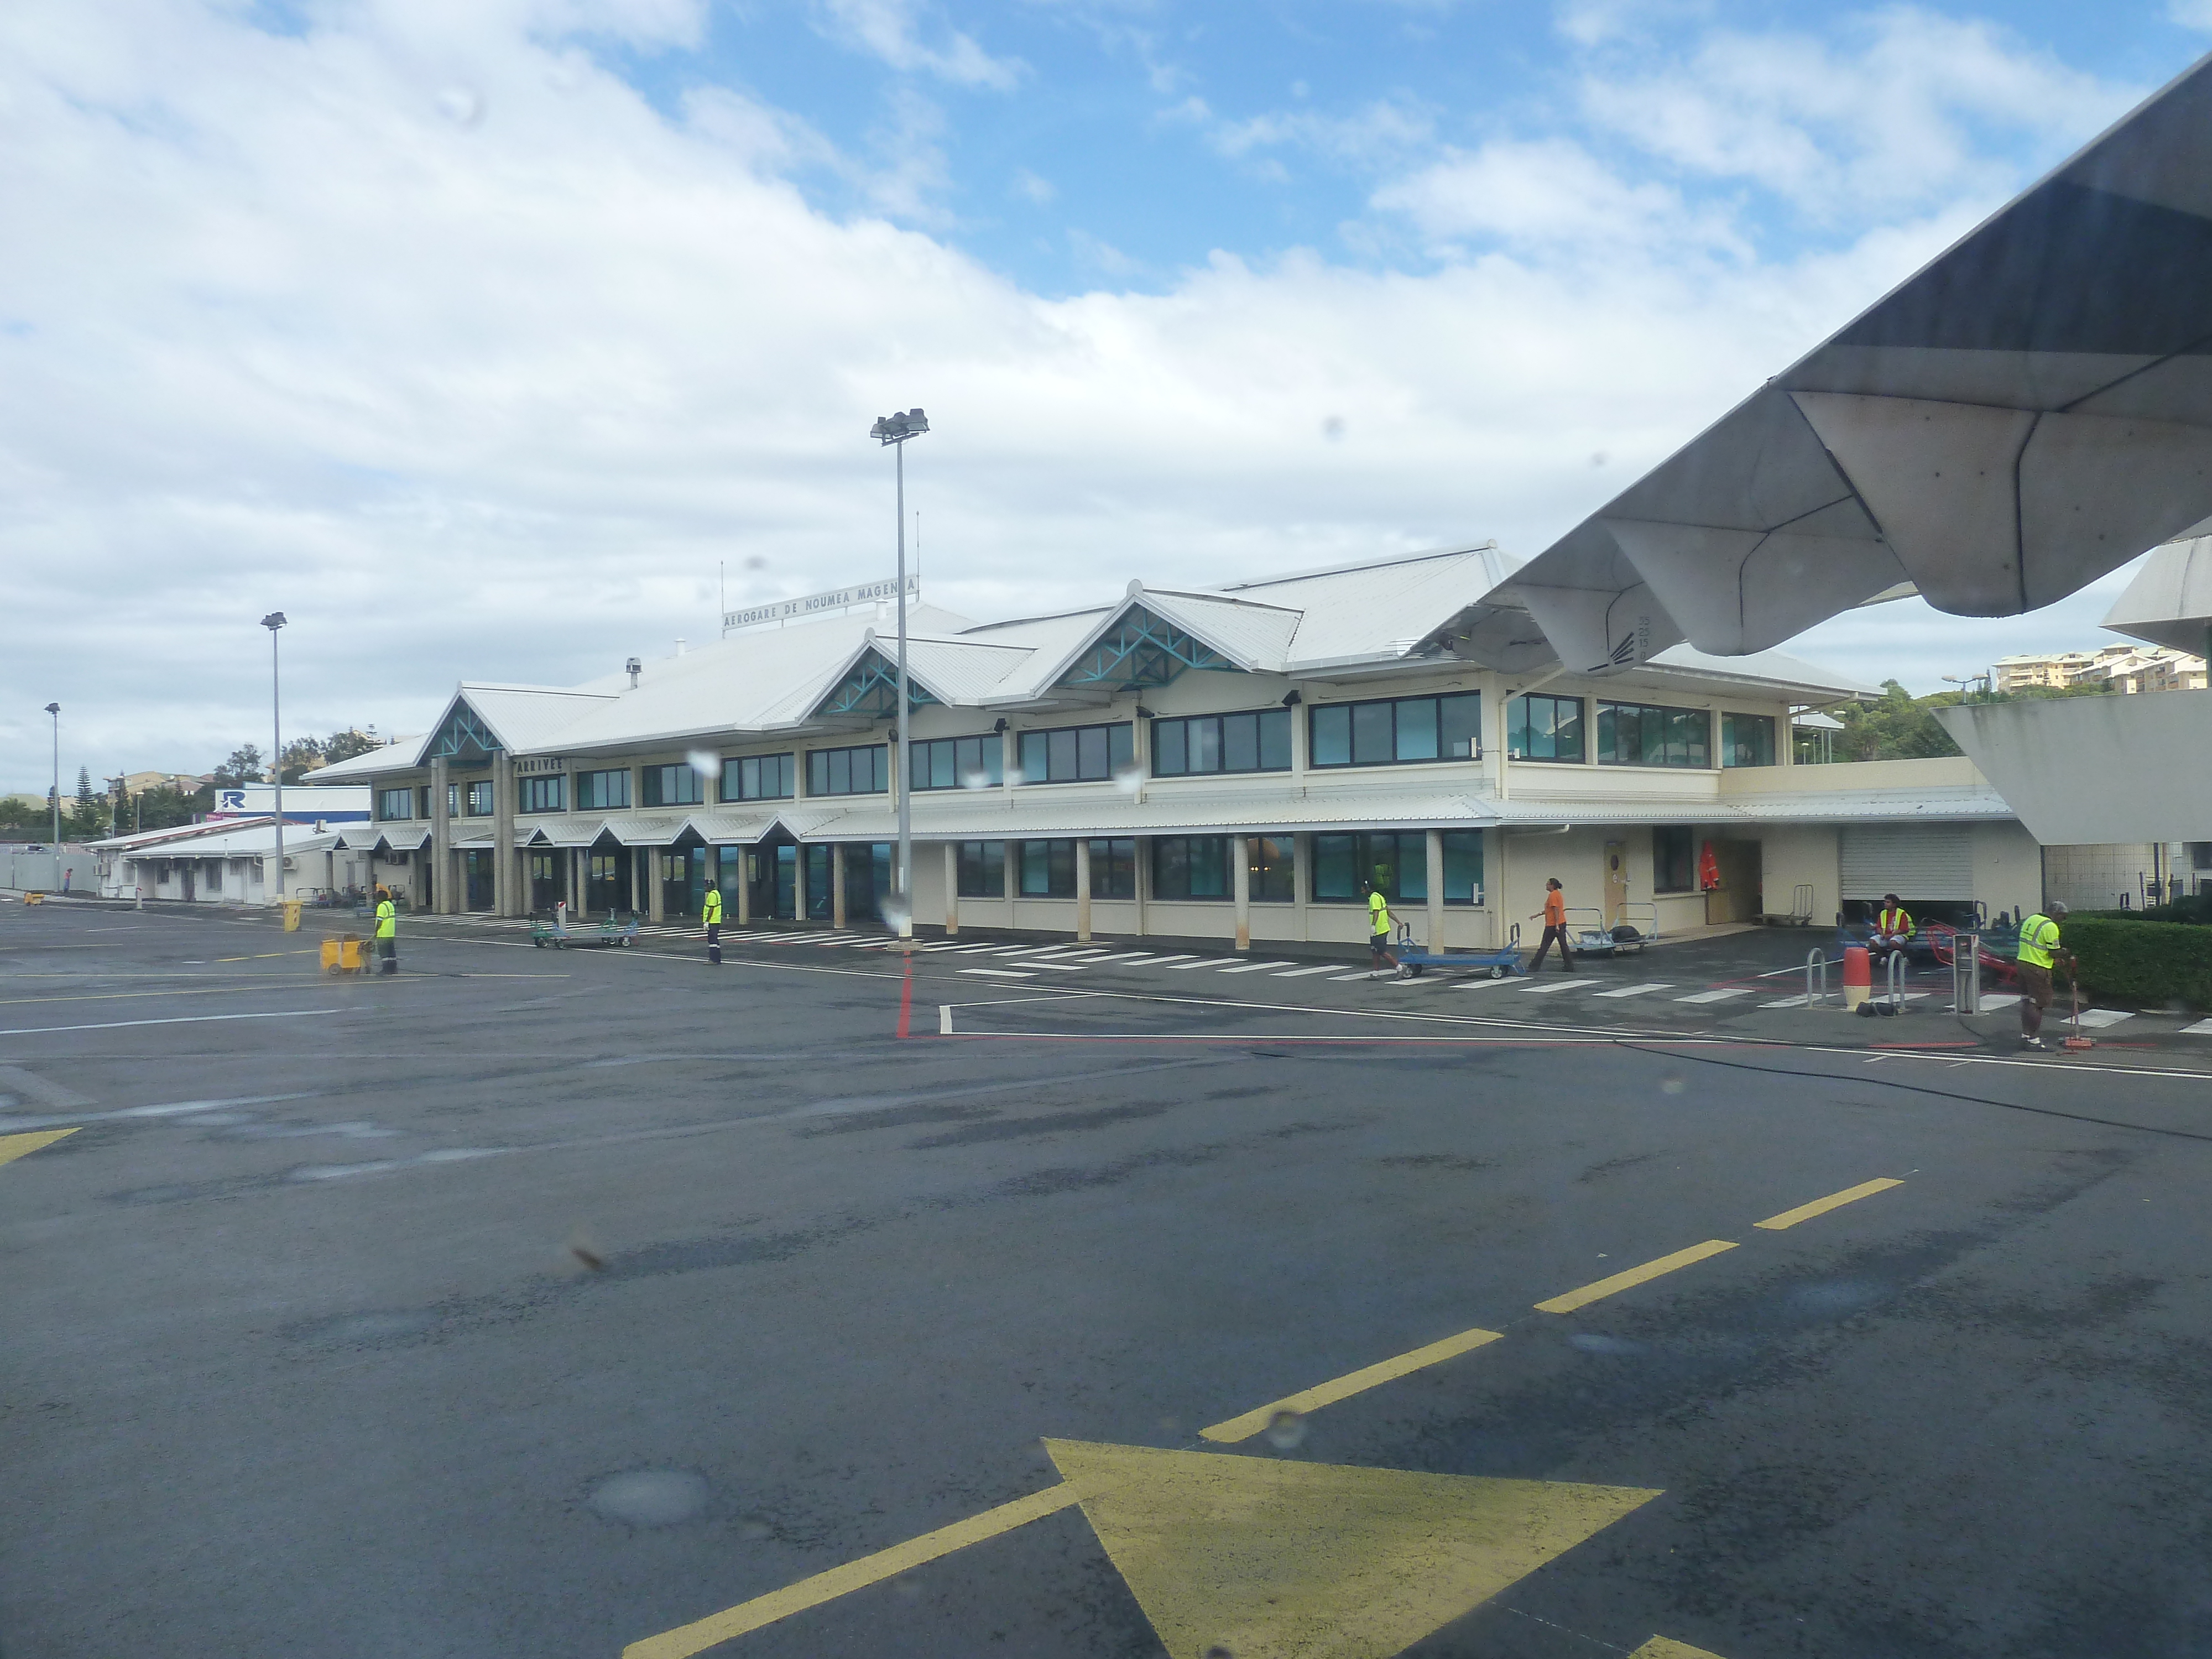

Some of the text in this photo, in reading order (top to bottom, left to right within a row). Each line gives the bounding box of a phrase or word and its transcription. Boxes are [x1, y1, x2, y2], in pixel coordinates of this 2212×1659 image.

[724, 579, 915, 627] AEROGARE DE NOUMEA MAGENA
[1640, 639, 1648, 647] 15
[223, 791, 246, 808] R
